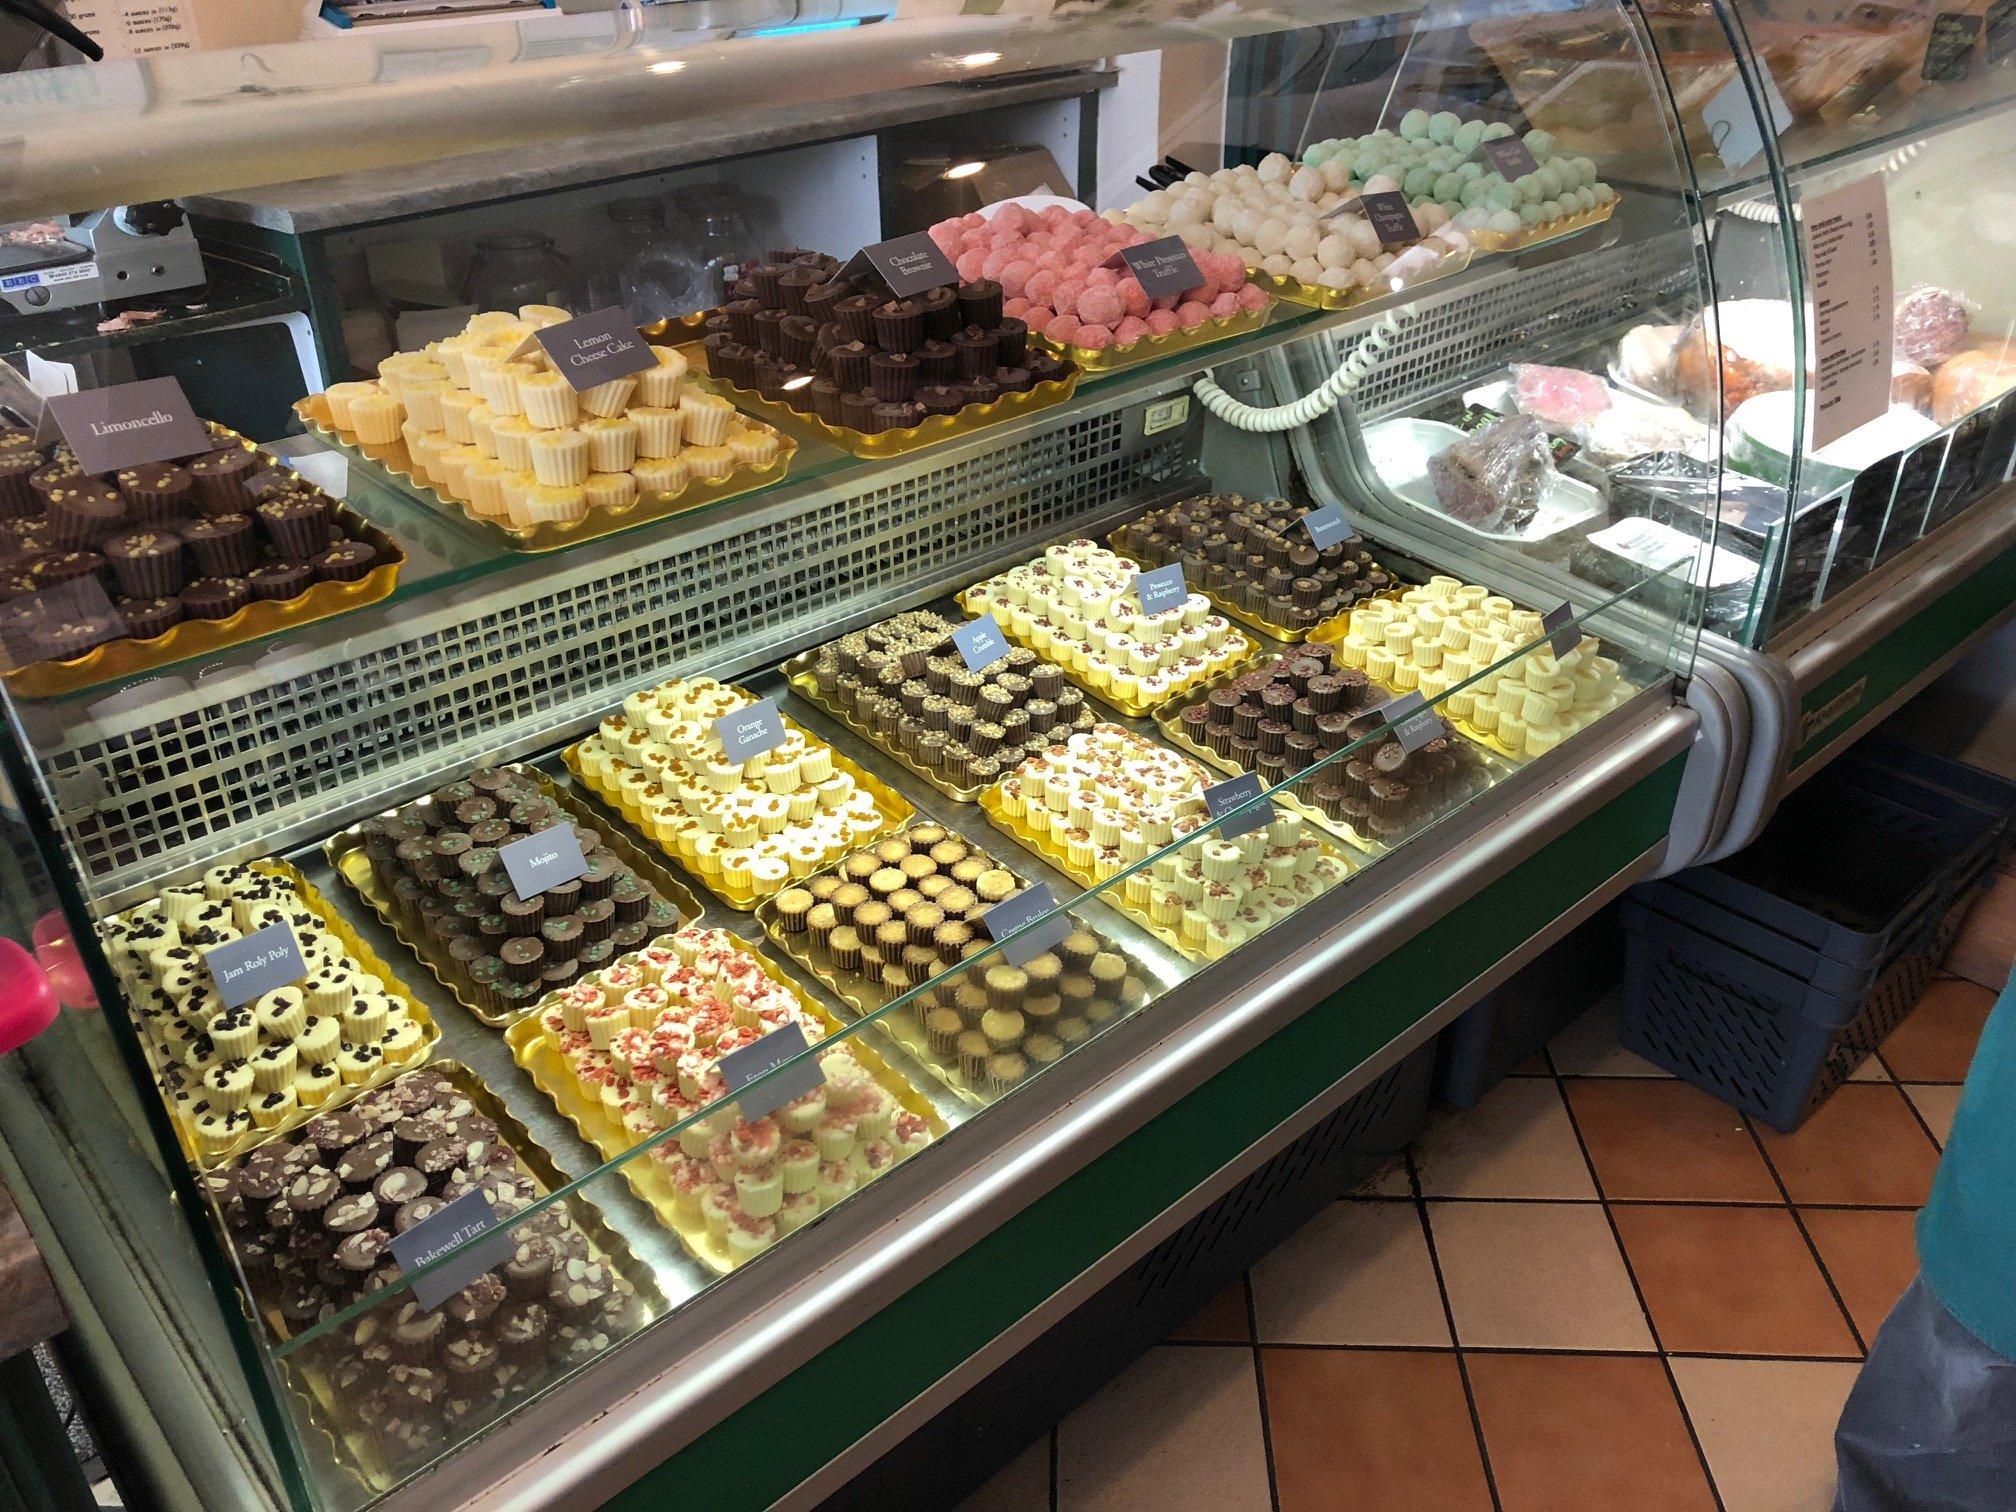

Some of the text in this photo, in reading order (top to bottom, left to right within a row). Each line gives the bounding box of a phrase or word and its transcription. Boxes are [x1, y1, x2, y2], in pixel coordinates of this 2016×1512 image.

[889, 251, 930, 267] Chocolate
[1131, 258, 1157, 271] White
[899, 262, 934, 276] Brownie
[1151, 264, 1179, 278] Truffle
[573, 332, 613, 350] Lemon
[570, 340, 635, 366] Cheese Cake
[89, 410, 174, 437] Limoncello
[1149, 579, 1173, 591] Prosecco
[1153, 586, 1180, 599] Raspberry
[972, 630, 988, 644] Apple
[737, 719, 763, 734] Orange
[738, 728, 768, 744] Ganache
[1217, 789, 1252, 807] Strawberry
[528, 852, 559, 868] Mojito
[222, 946, 290, 984] Jam Roly Poly
[414, 1219, 487, 1268] Bakewell Tart
